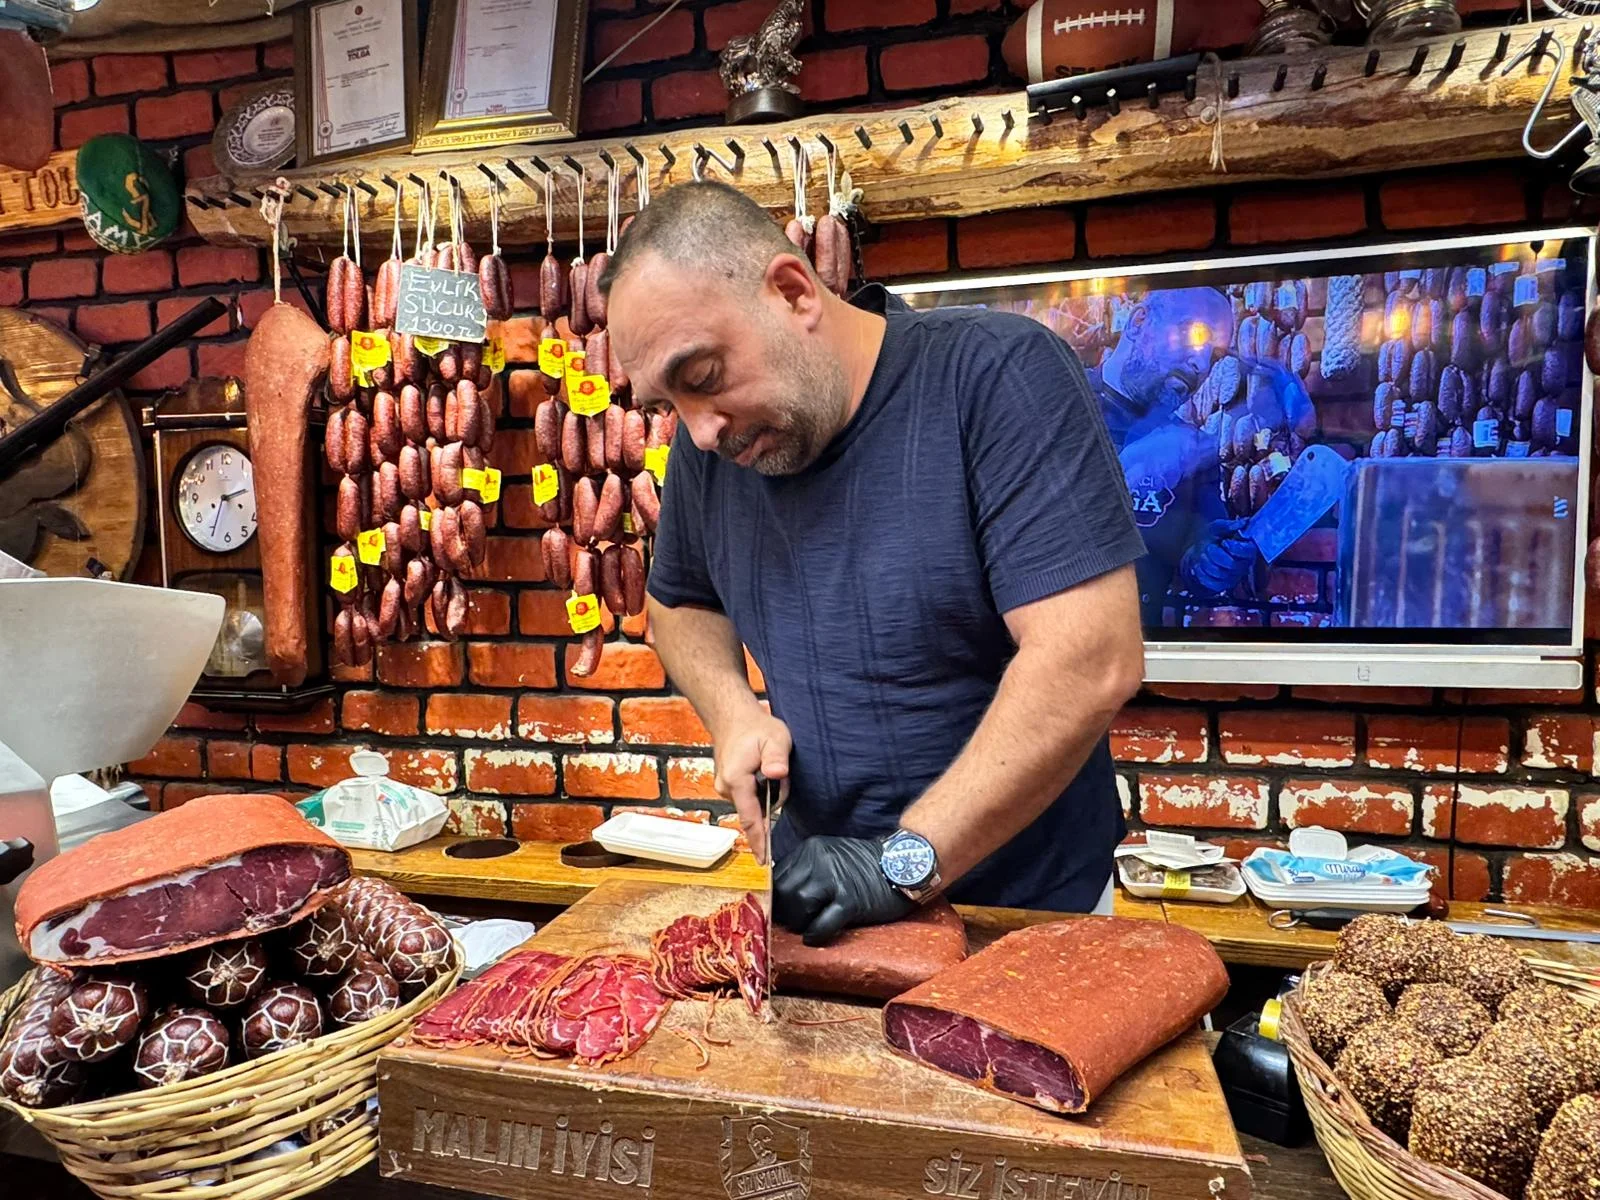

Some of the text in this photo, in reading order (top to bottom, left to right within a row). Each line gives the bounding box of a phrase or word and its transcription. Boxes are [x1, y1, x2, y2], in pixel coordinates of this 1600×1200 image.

[404, 293, 475, 321] SUCUK
[407, 316, 475, 337] 1300 TL
[192, 492, 199, 504] 9
[196, 512, 203, 523] 8
[223, 531, 232, 543] 6
[240, 525, 249, 538] 5
[412, 1106, 656, 1188] MALIN İYİSİ
[922, 1147, 984, 1199] SİZ
